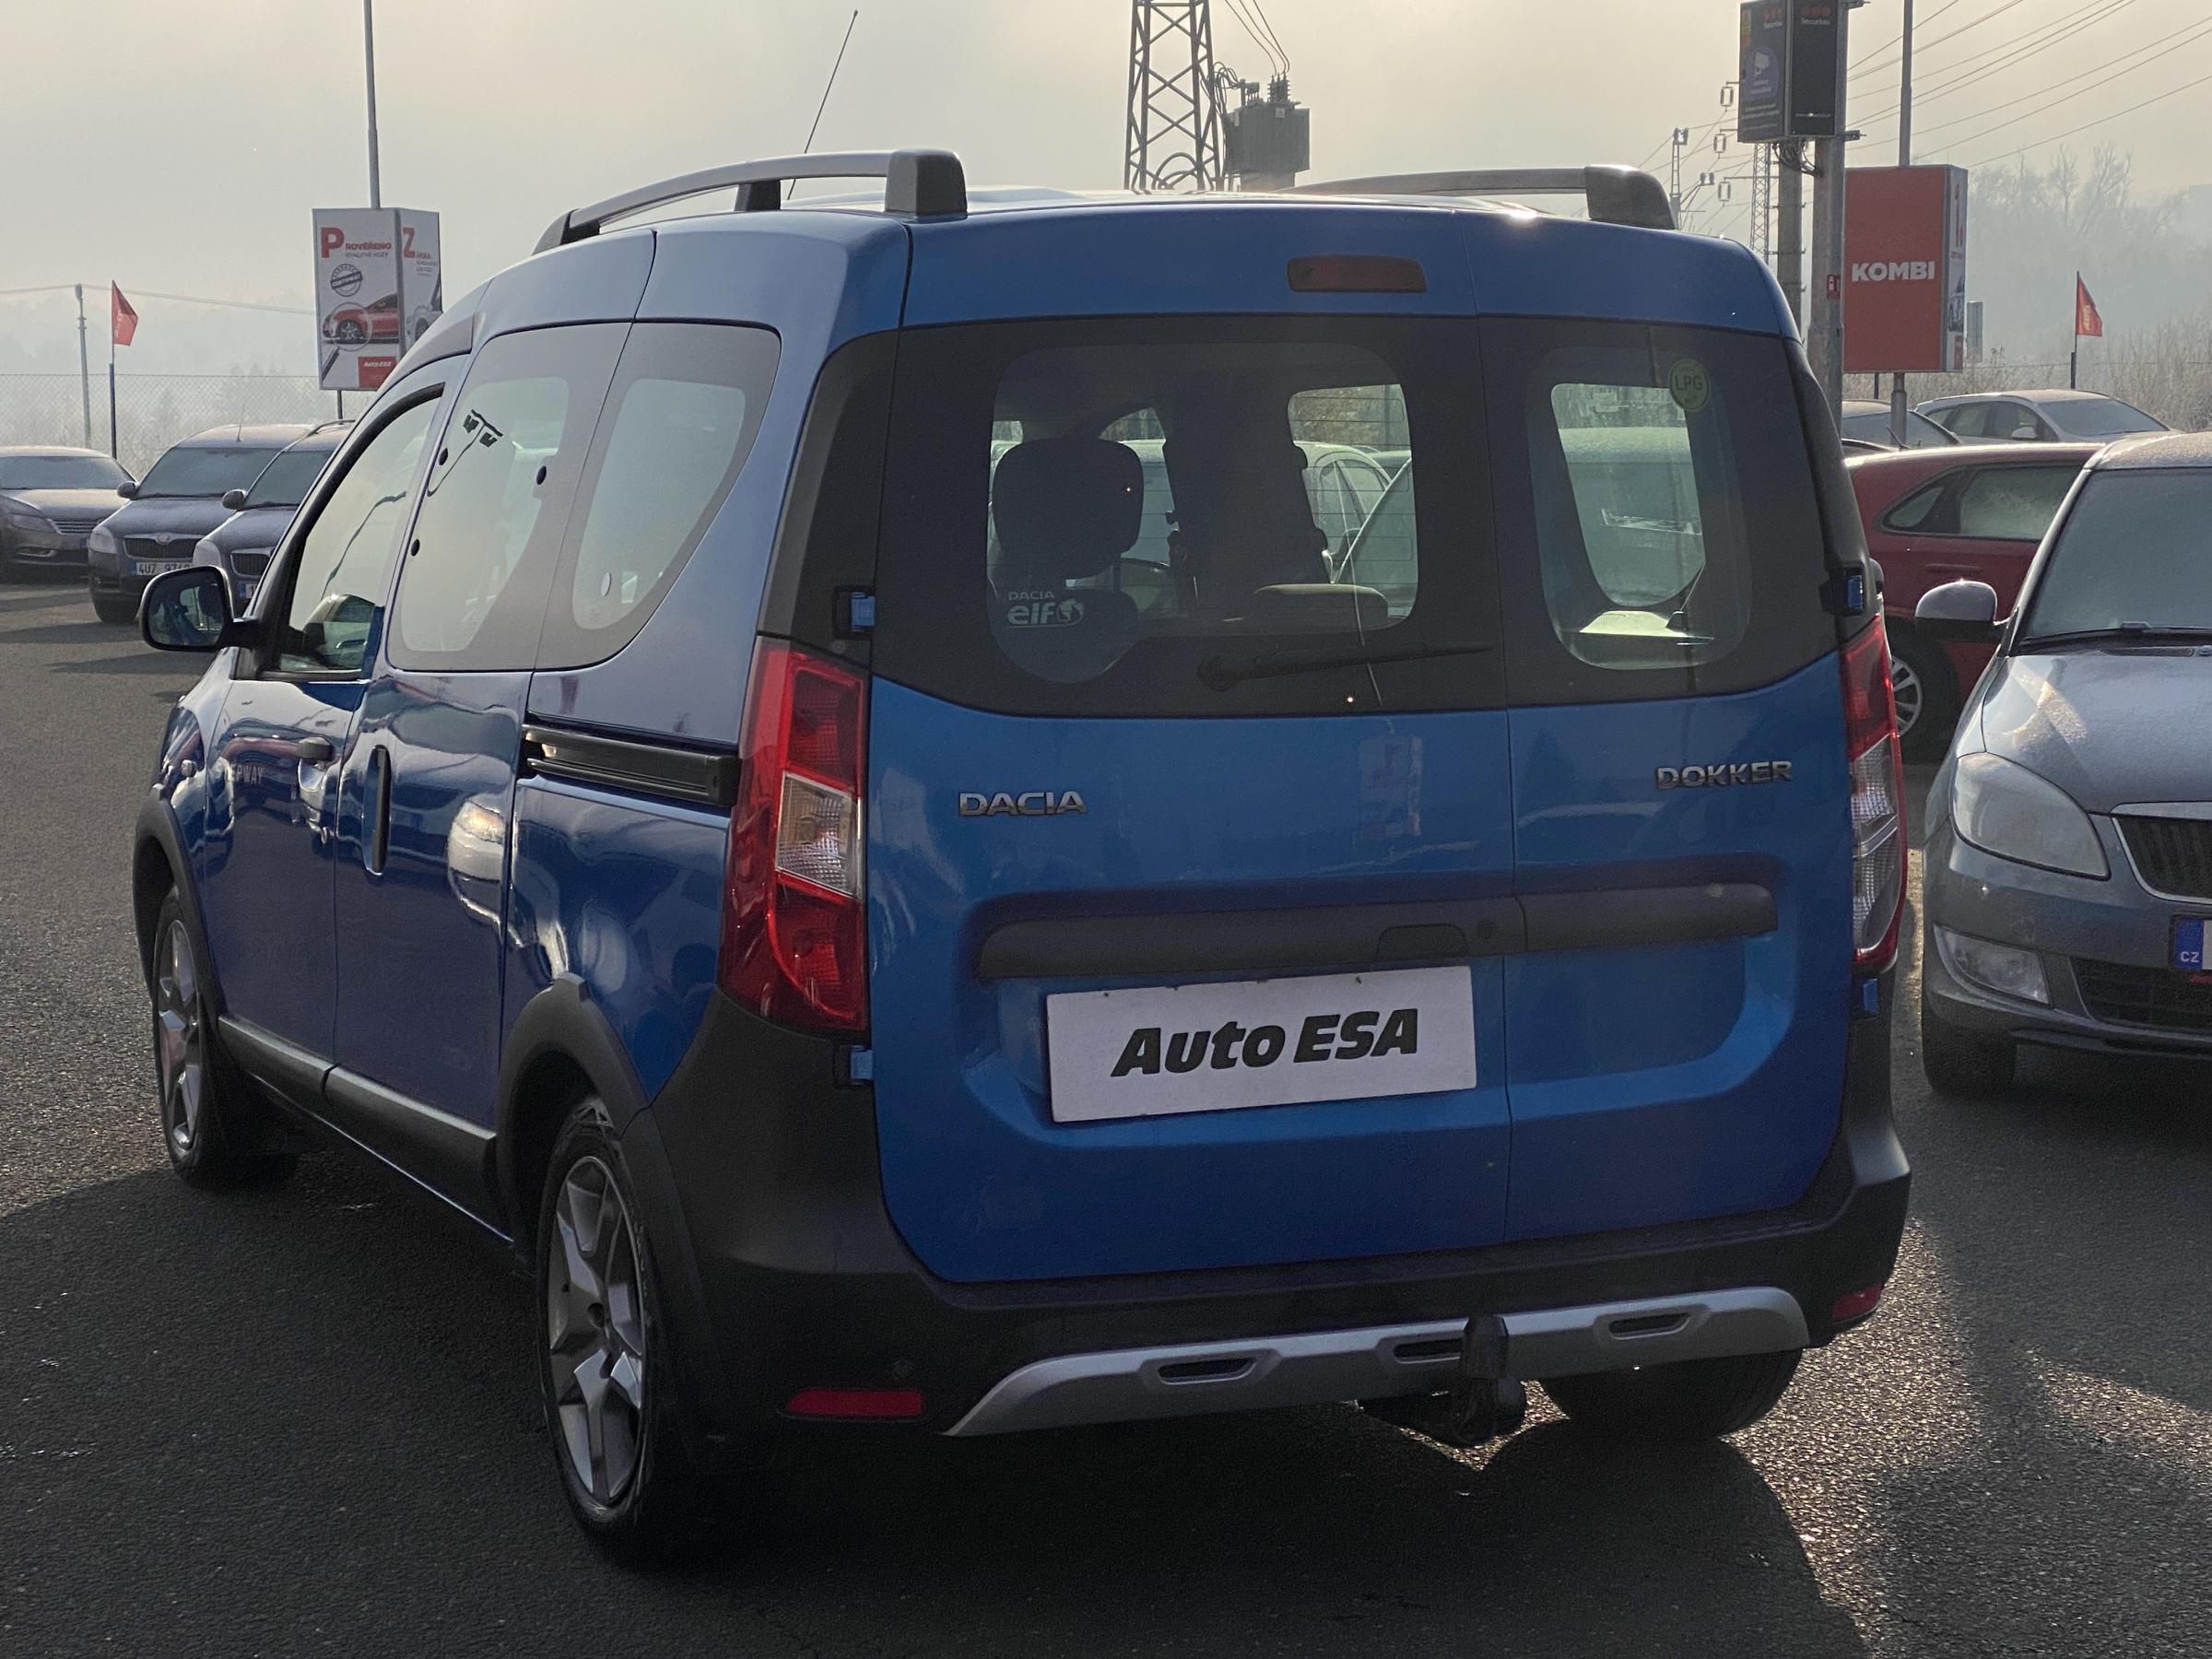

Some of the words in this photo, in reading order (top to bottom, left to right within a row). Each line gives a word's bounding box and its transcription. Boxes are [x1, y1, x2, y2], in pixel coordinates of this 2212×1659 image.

[1851, 260, 1936, 282] KOMBI
[1674, 374, 1704, 391] LPG
[1007, 590, 1055, 601] DACIA
[1006, 602, 1057, 625] elf
[1655, 759, 1793, 791] DOKKER
[959, 789, 1088, 817] DACIA
[2180, 951, 2200, 963] CZ
[1109, 1019, 1287, 1077] Auto
[1292, 1007, 1418, 1064] ESA
